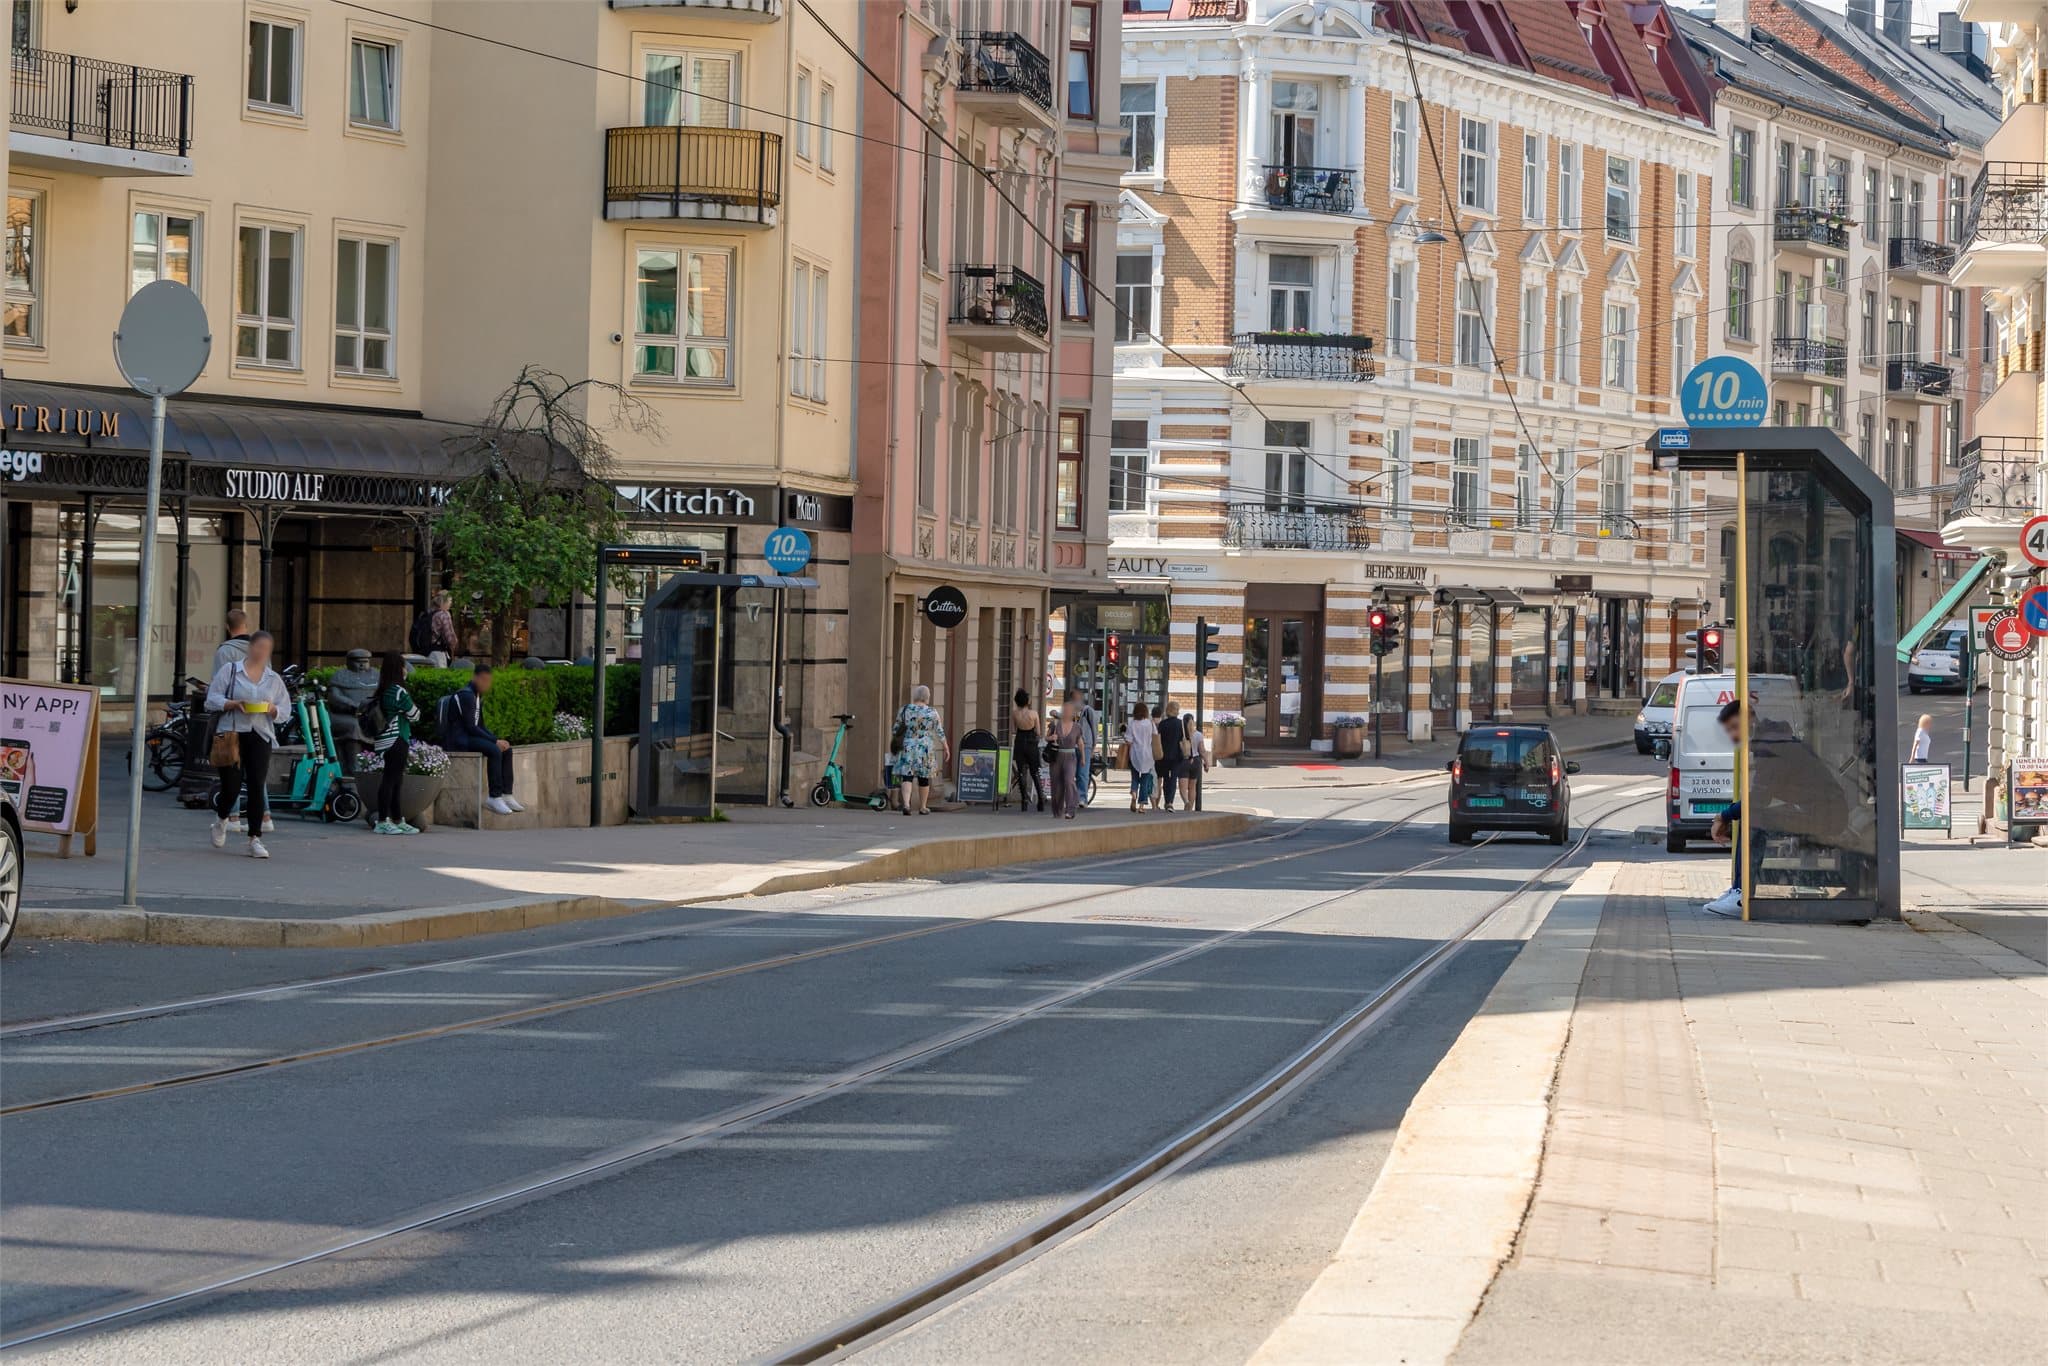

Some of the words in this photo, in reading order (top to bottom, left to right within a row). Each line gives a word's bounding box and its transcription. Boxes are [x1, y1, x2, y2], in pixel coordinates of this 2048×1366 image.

[1695, 371, 1740, 409] 10
[1737, 396, 1764, 409] min
[226, 469, 289, 500] STUDIO
[292, 473, 324, 501] ALF
[772, 534, 796, 556] 10
[2028, 528, 2048, 552] 4
[1395, 566, 1427, 580] BEAUTY
[1992, 645, 2004, 656] HOT
[2004, 646, 2032, 659] BURGERS
[4, 693, 30, 710] NY
[35, 697, 79, 715] APP!
